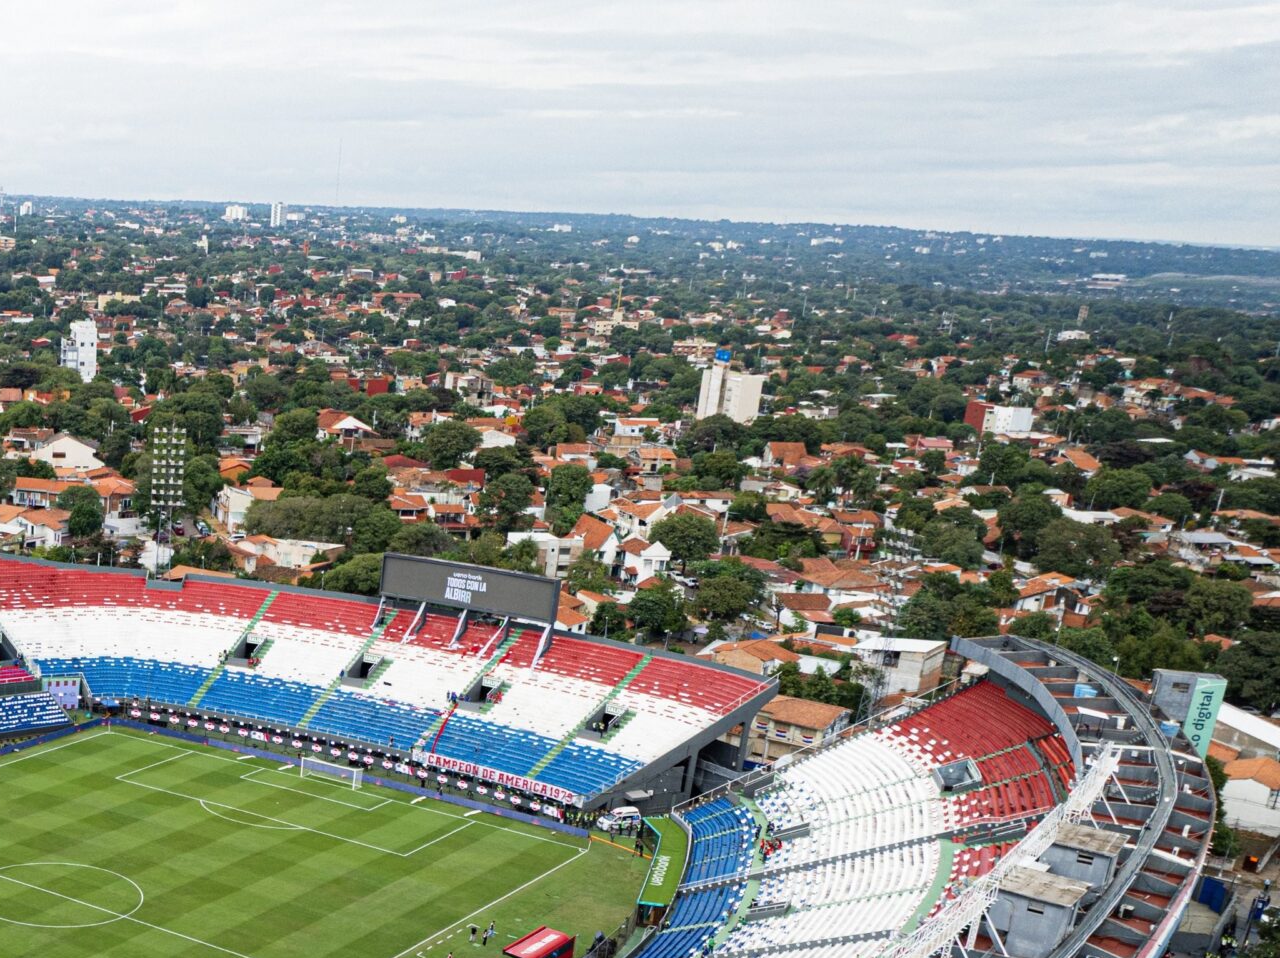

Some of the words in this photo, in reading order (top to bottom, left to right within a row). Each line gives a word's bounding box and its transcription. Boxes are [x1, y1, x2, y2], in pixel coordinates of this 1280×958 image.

[447, 577, 465, 589] TODOS
[466, 581, 479, 591] CON
[479, 582, 487, 592] LA
[468, 573, 482, 581] bank
[1192, 690, 1214, 731] digital
[427, 754, 479, 776] CAMPEON
[482, 768, 495, 781] DE
[497, 773, 548, 797] AMERICA
